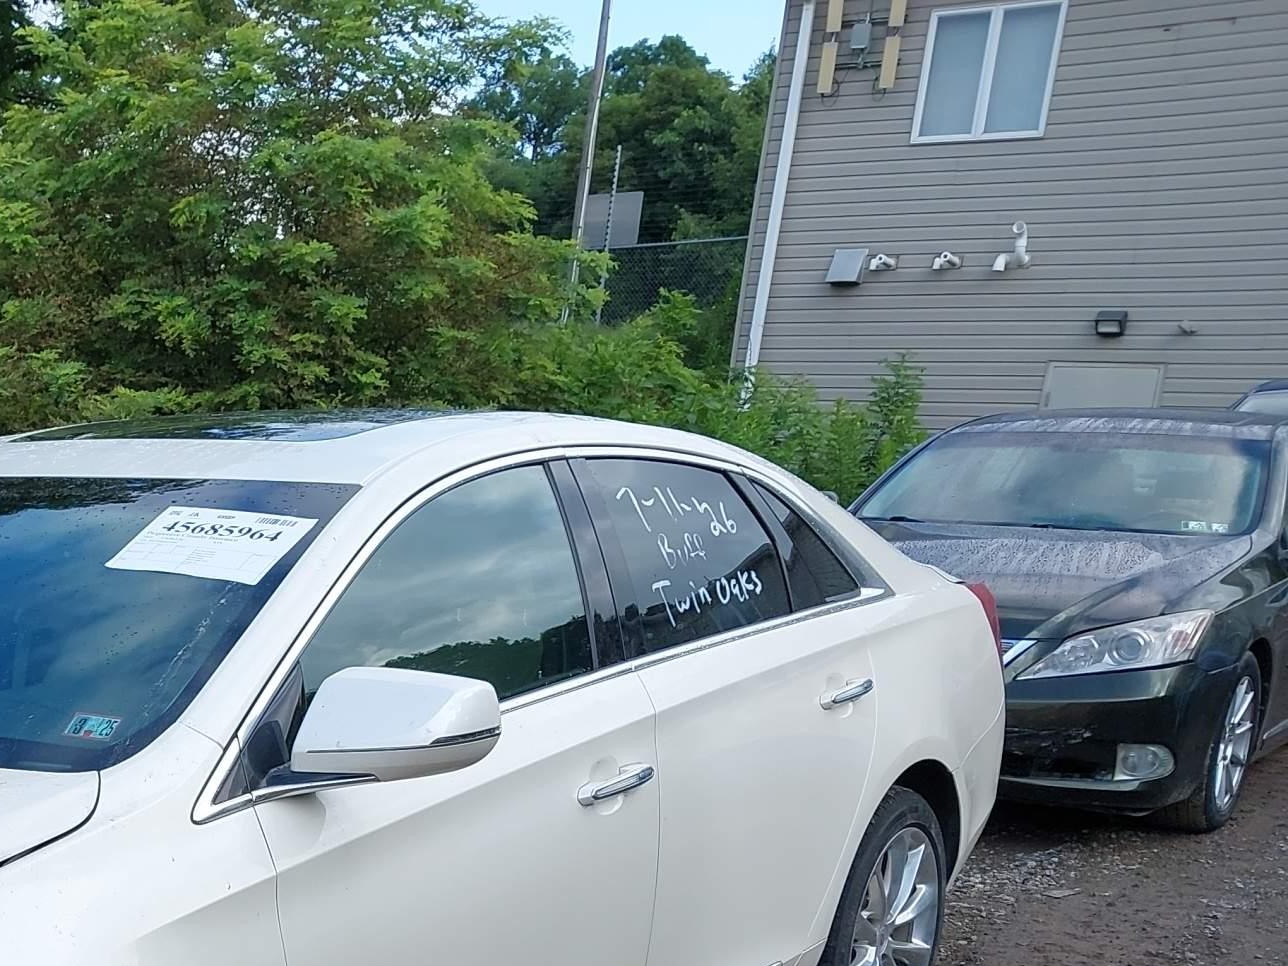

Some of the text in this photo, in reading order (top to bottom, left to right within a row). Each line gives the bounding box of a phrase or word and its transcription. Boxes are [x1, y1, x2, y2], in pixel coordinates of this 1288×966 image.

[162, 520, 284, 542] 45685964
[651, 579, 712, 628] Twin
[98, 719, 119, 736] 25
